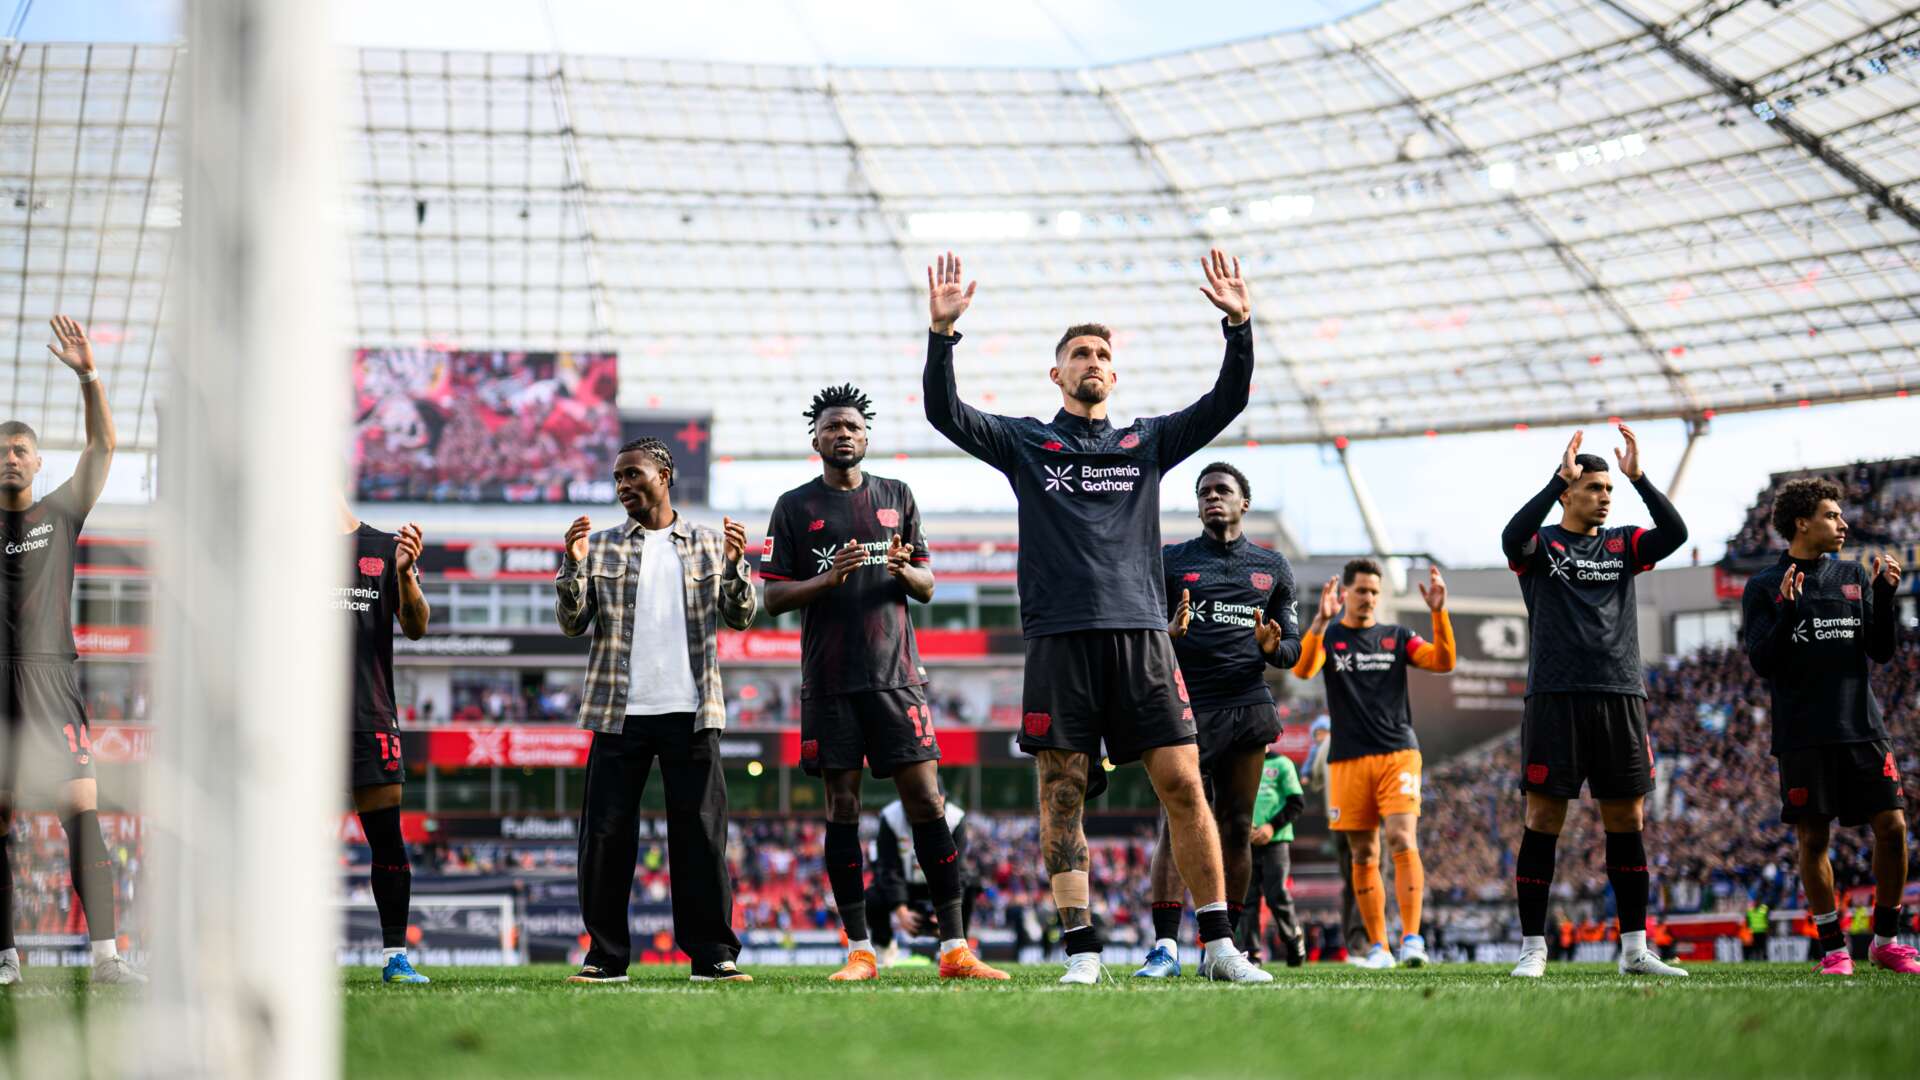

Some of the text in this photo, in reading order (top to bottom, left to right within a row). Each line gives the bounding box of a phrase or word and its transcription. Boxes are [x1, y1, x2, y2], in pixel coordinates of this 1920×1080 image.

[1081, 465, 1140, 478] Barmenia
[1081, 480, 1134, 492] Gothaer
[5, 538, 49, 555] Gothaer
[1576, 569, 1620, 581] Gothaer
[1212, 612, 1257, 628] Gothae
